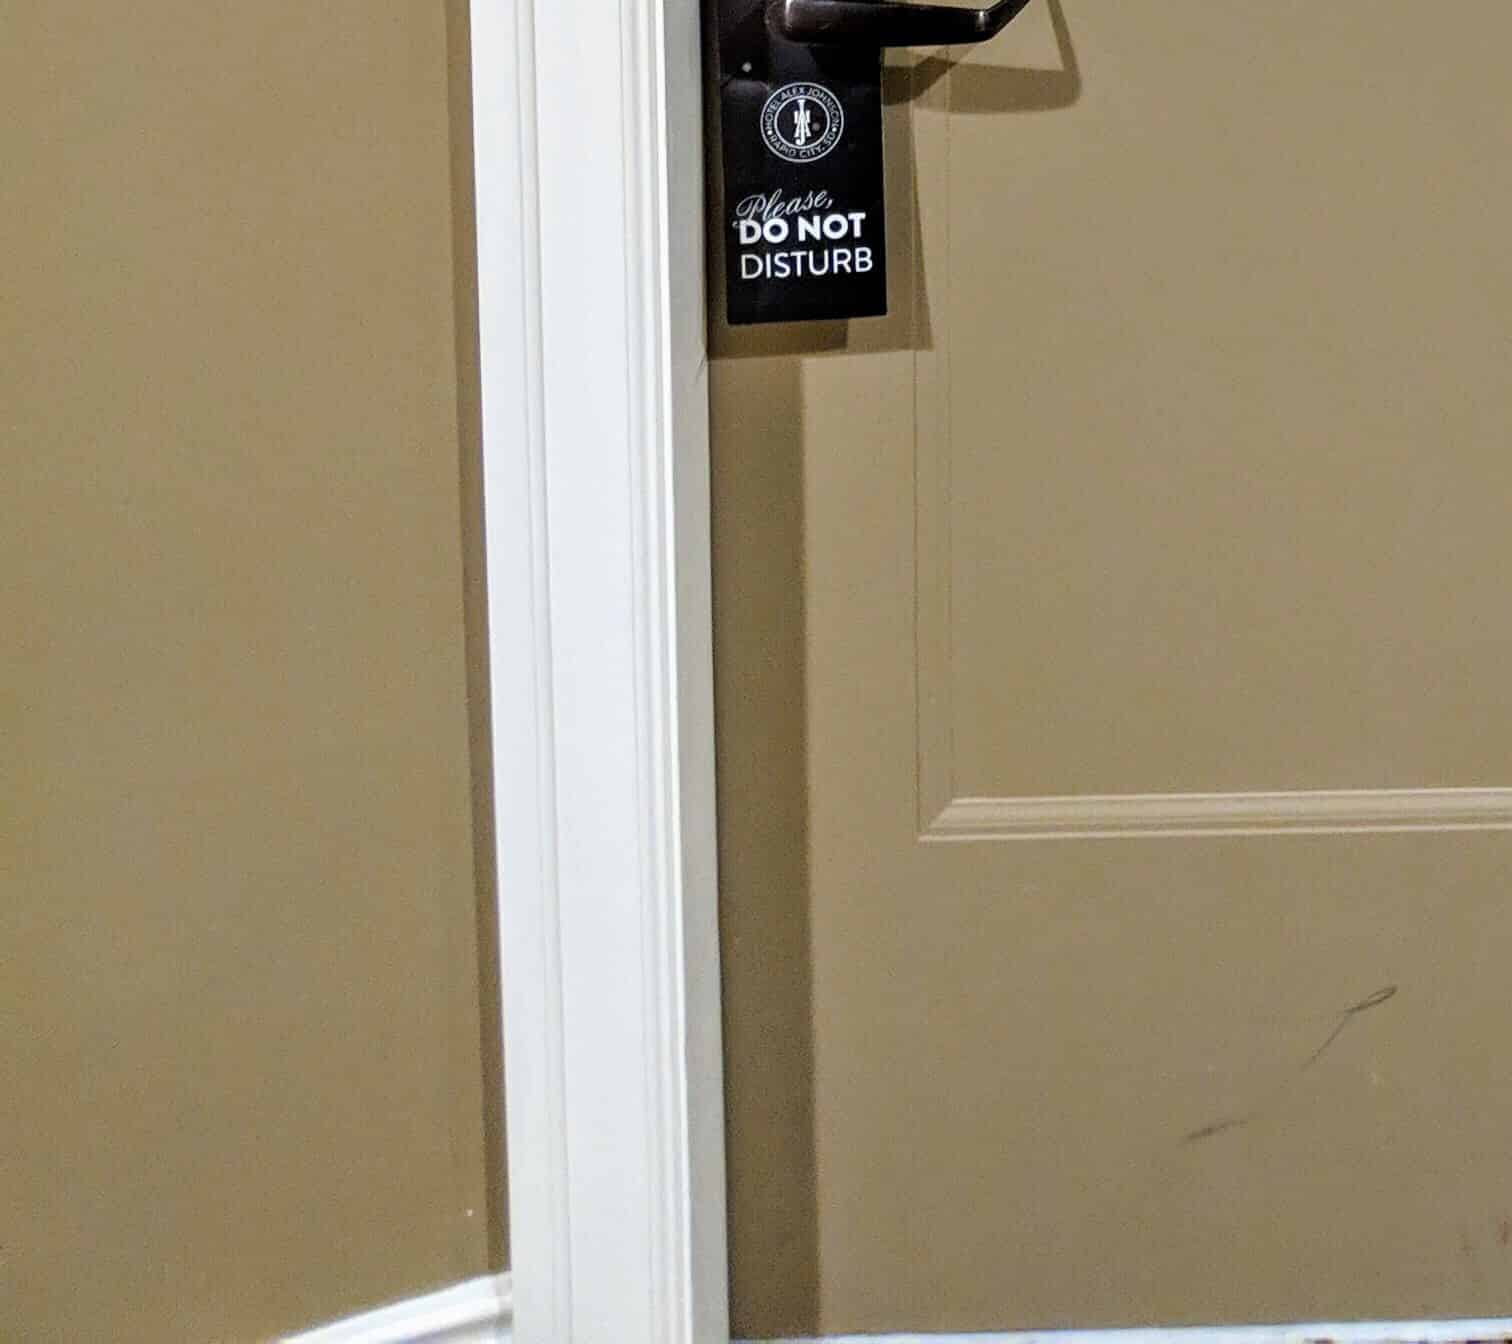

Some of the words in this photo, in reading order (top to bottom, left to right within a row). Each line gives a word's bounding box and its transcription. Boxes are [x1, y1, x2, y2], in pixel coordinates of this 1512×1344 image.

[734, 188, 834, 223] Please,
[739, 217, 789, 246] DO
[797, 211, 867, 243] NOT
[740, 246, 874, 280] DISTURB
